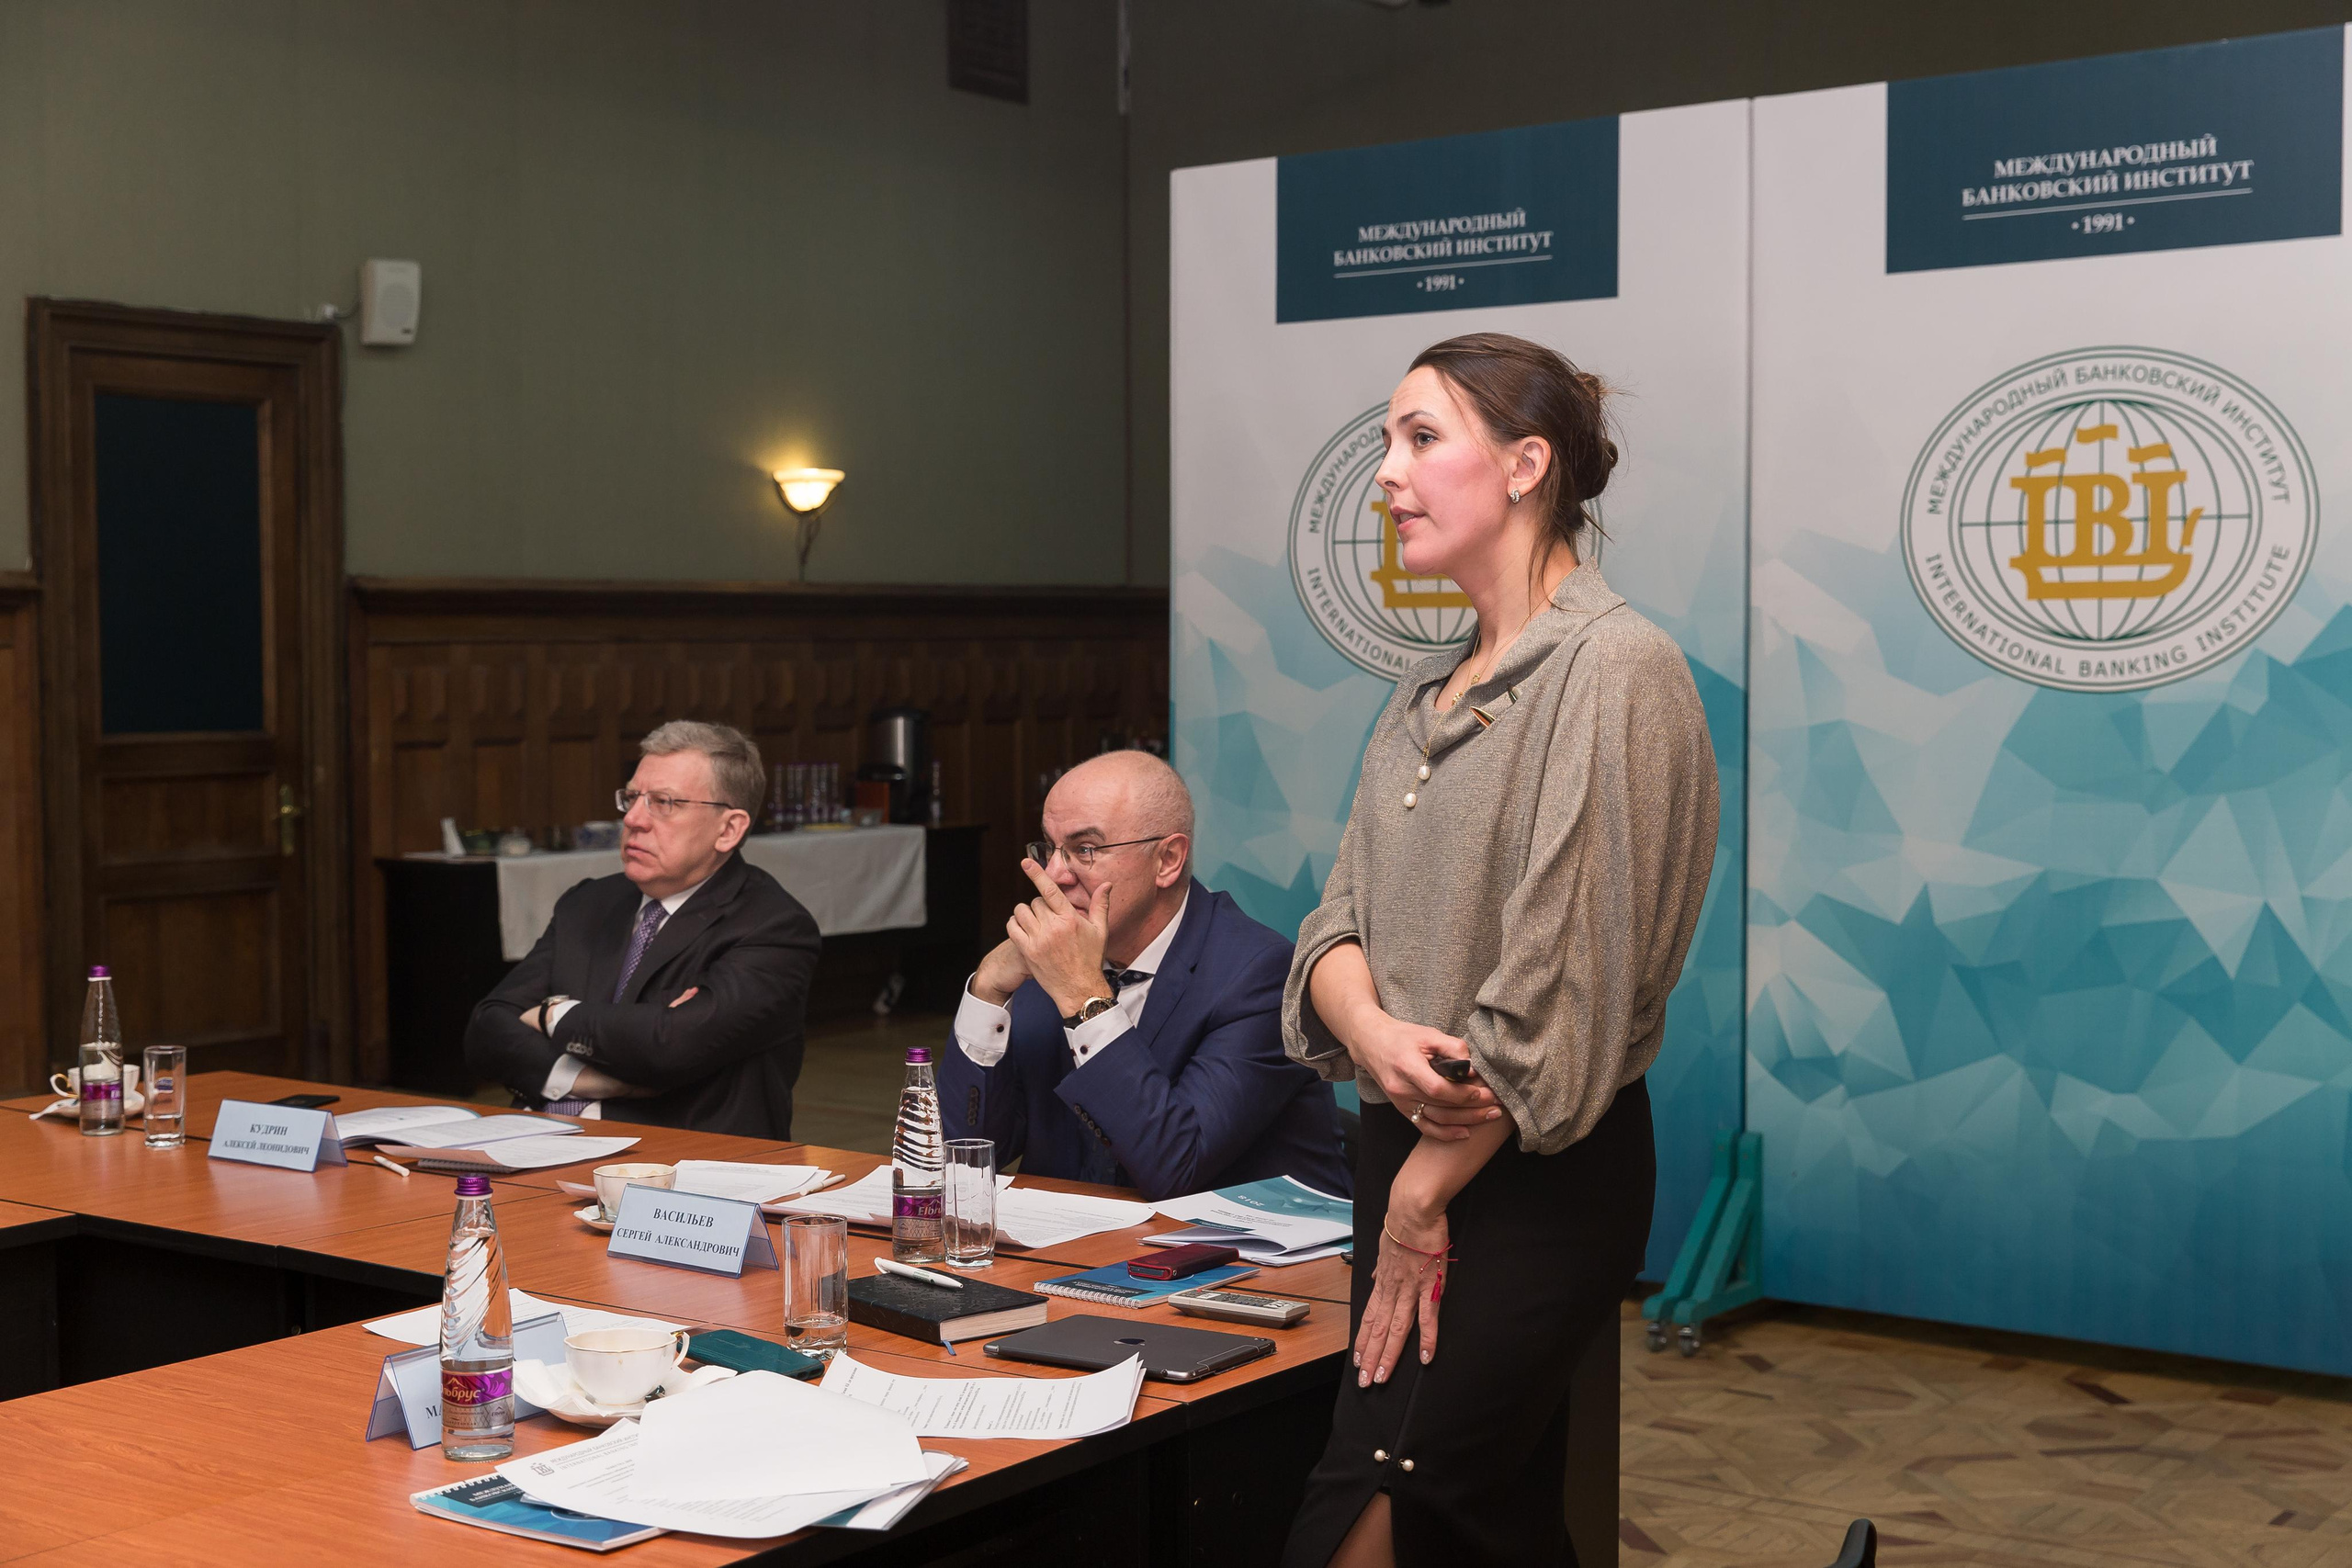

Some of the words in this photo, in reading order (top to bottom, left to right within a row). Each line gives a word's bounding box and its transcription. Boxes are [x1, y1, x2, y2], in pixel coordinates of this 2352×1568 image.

[1993, 133, 2218, 179] МЕЖДУНАРОДНЫЙ
[1962, 171, 2119, 208] БАНКОВСКИЙ
[2123, 159, 2254, 192] ИНСТИТУТ
[1358, 208, 1527, 243] МЕЖДУНАРОДНЫЙ
[2081, 214, 2125, 234] 1991
[1333, 237, 1452, 267] БАНКОВСКИЙ
[1455, 231, 1555, 258] ИНСТИТУТ
[1423, 275, 1456, 293] 1991
[1928, 368, 2068, 515] МЕЖДУНАРОДНЫЙ
[2075, 363, 2222, 408] БАНКОВСКИЙ
[2219, 398, 2291, 504] ИНСТИТУТ
[1309, 425, 1383, 534] МЕЖДУНАРОД
[1925, 553, 2066, 675] INTERNATIONAL
[2078, 645, 2188, 677] BANKING
[2197, 544, 2290, 653] INSTITUTE
[249, 1123, 288, 1135] КУДРИН
[222, 1139, 256, 1149] АЛЕКСЕЙ
[257, 1143, 310, 1155] ЛЕОНИДОВИЧ
[653, 1208, 714, 1227] ВАСИЛЬЕВ
[616, 1227, 651, 1242] СЕРГЕЙ
[654, 1235, 740, 1258] АЛЕКСАНДРОВИЧ
[442, 1385, 481, 1402] льбрус
